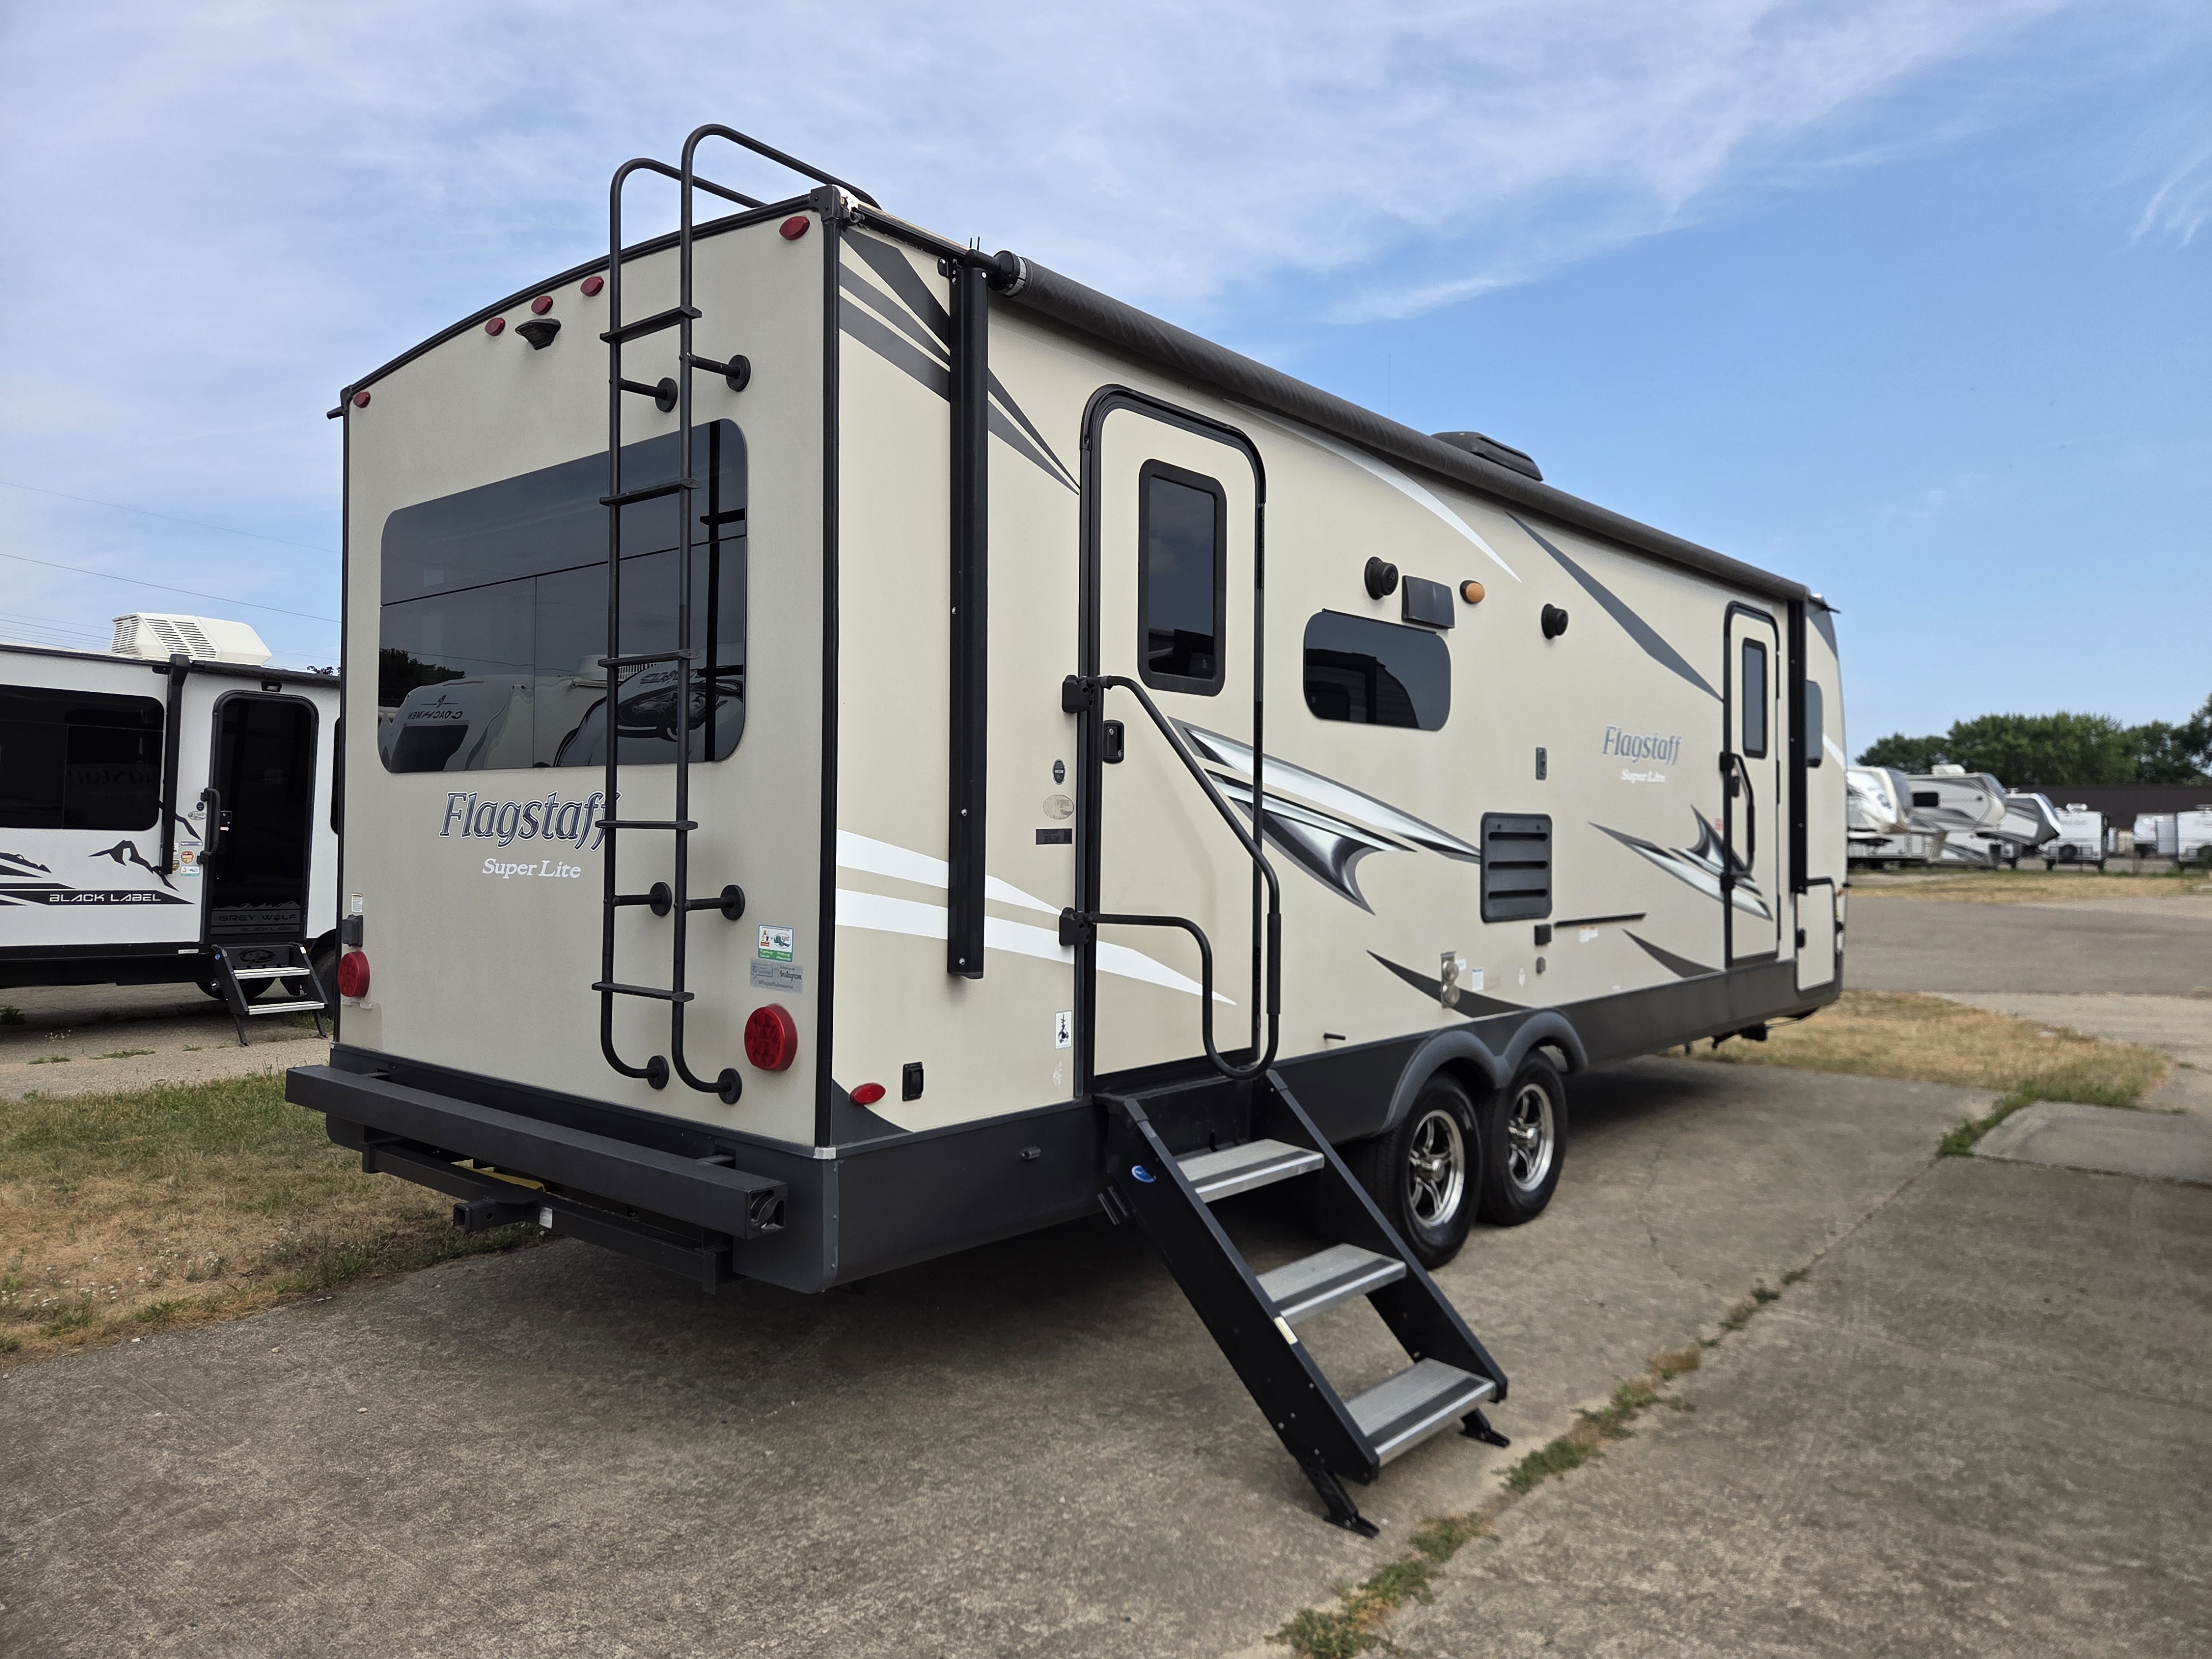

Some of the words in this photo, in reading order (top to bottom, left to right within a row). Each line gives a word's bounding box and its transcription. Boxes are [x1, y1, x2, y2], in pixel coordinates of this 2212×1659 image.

[1601, 724, 1682, 768] Flagstaff
[1621, 768, 1647, 783] Super
[482, 858, 537, 879] Super
[538, 860, 581, 878] Lite
[49, 894, 105, 902] BLACK
[111, 893, 161, 902] LABEL
